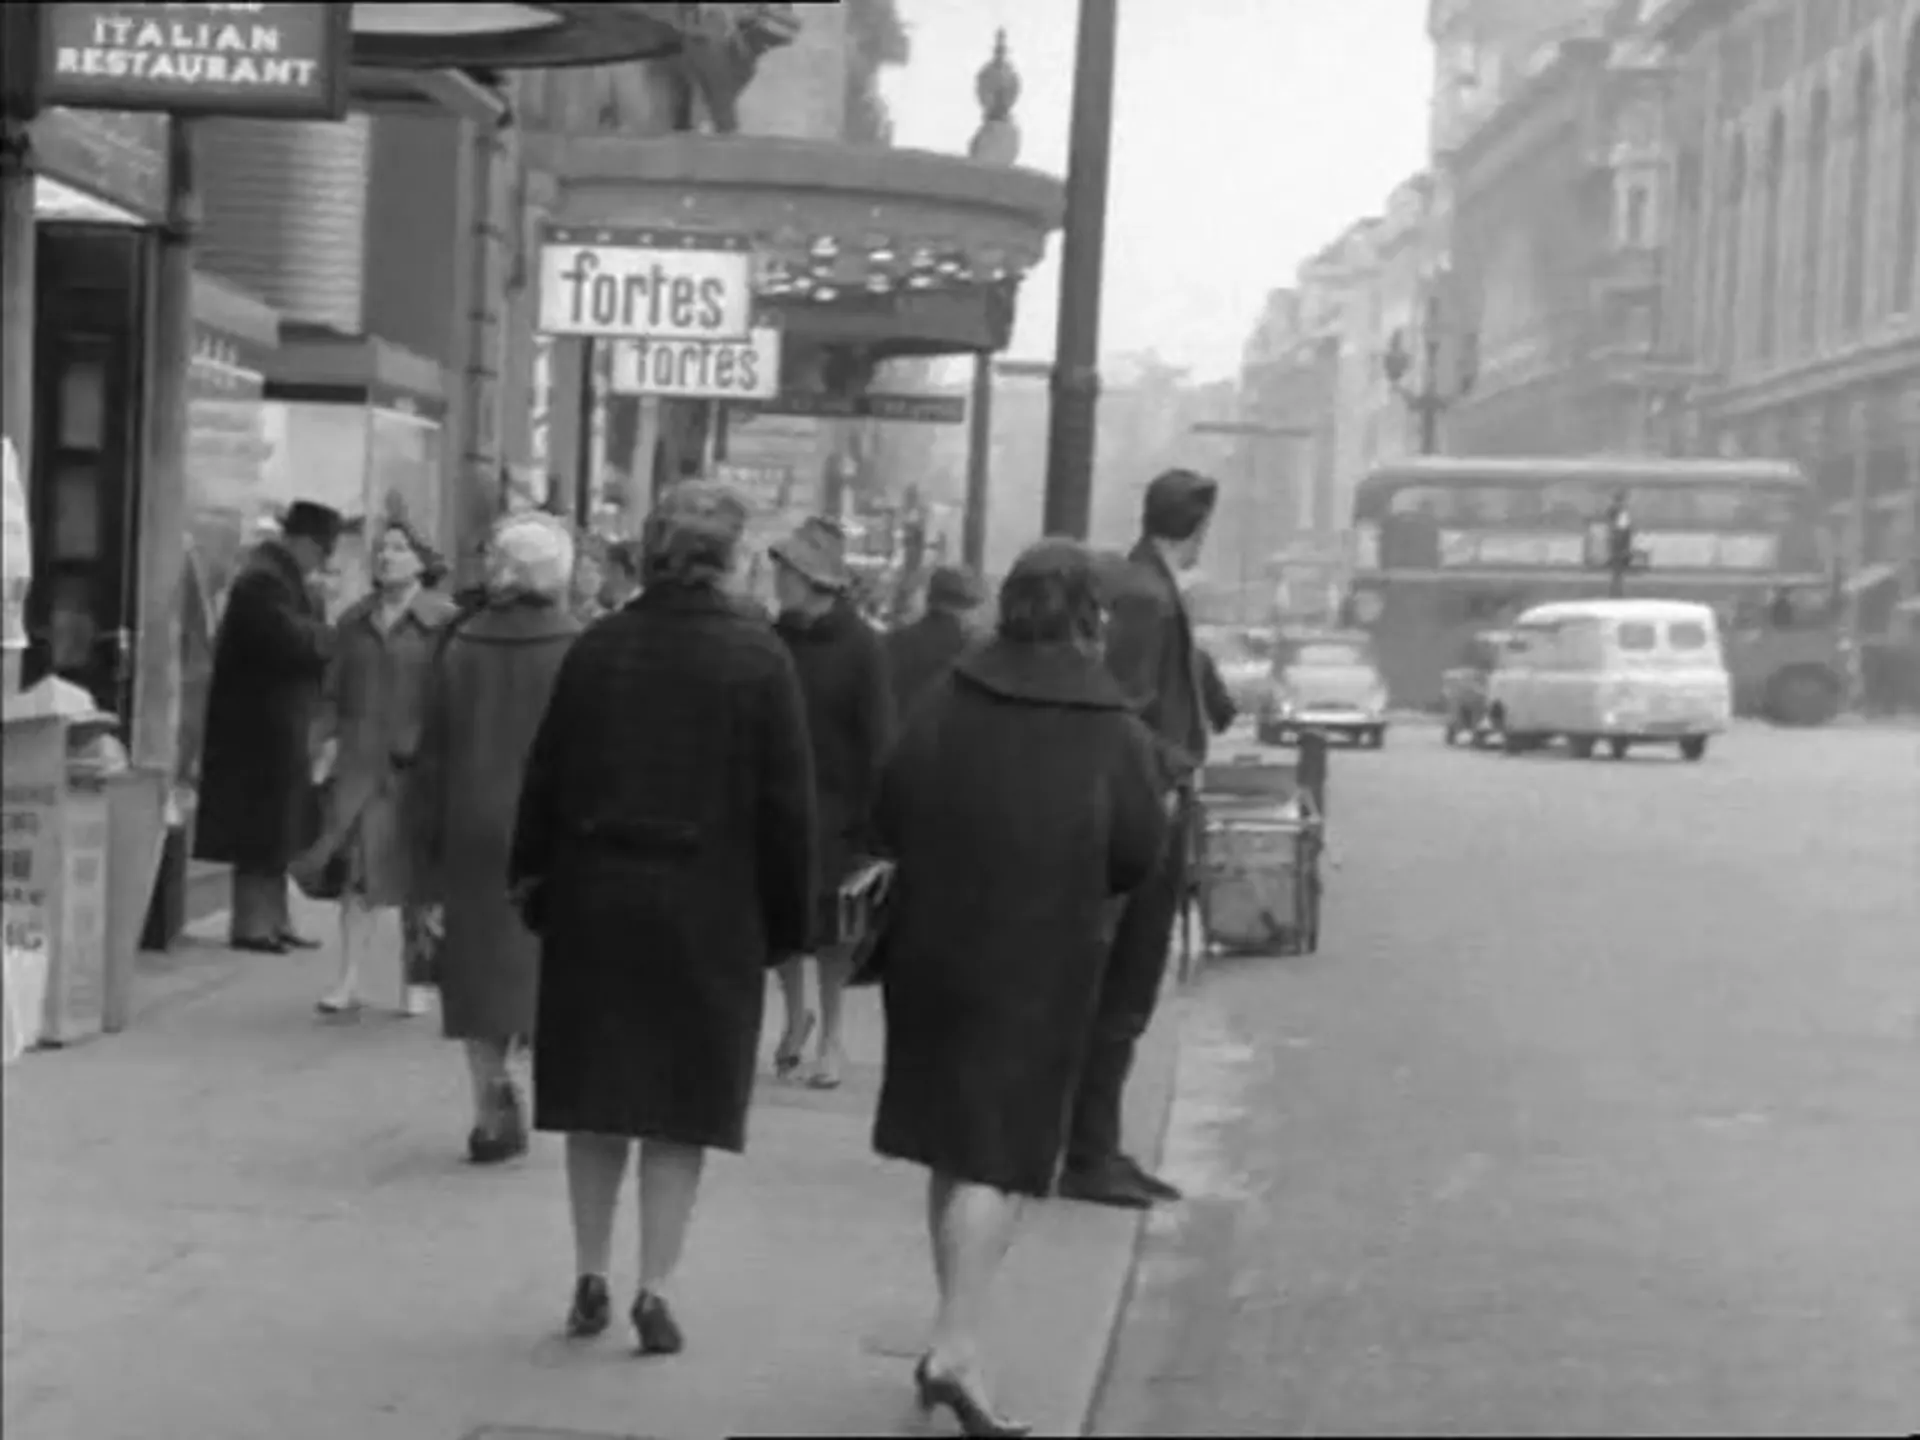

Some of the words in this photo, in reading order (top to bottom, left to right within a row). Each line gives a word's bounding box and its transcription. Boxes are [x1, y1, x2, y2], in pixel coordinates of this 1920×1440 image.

[94, 17, 279, 50] ITALIAN
[56, 47, 316, 86] RESTAURANT
[561, 251, 725, 329] fortes
